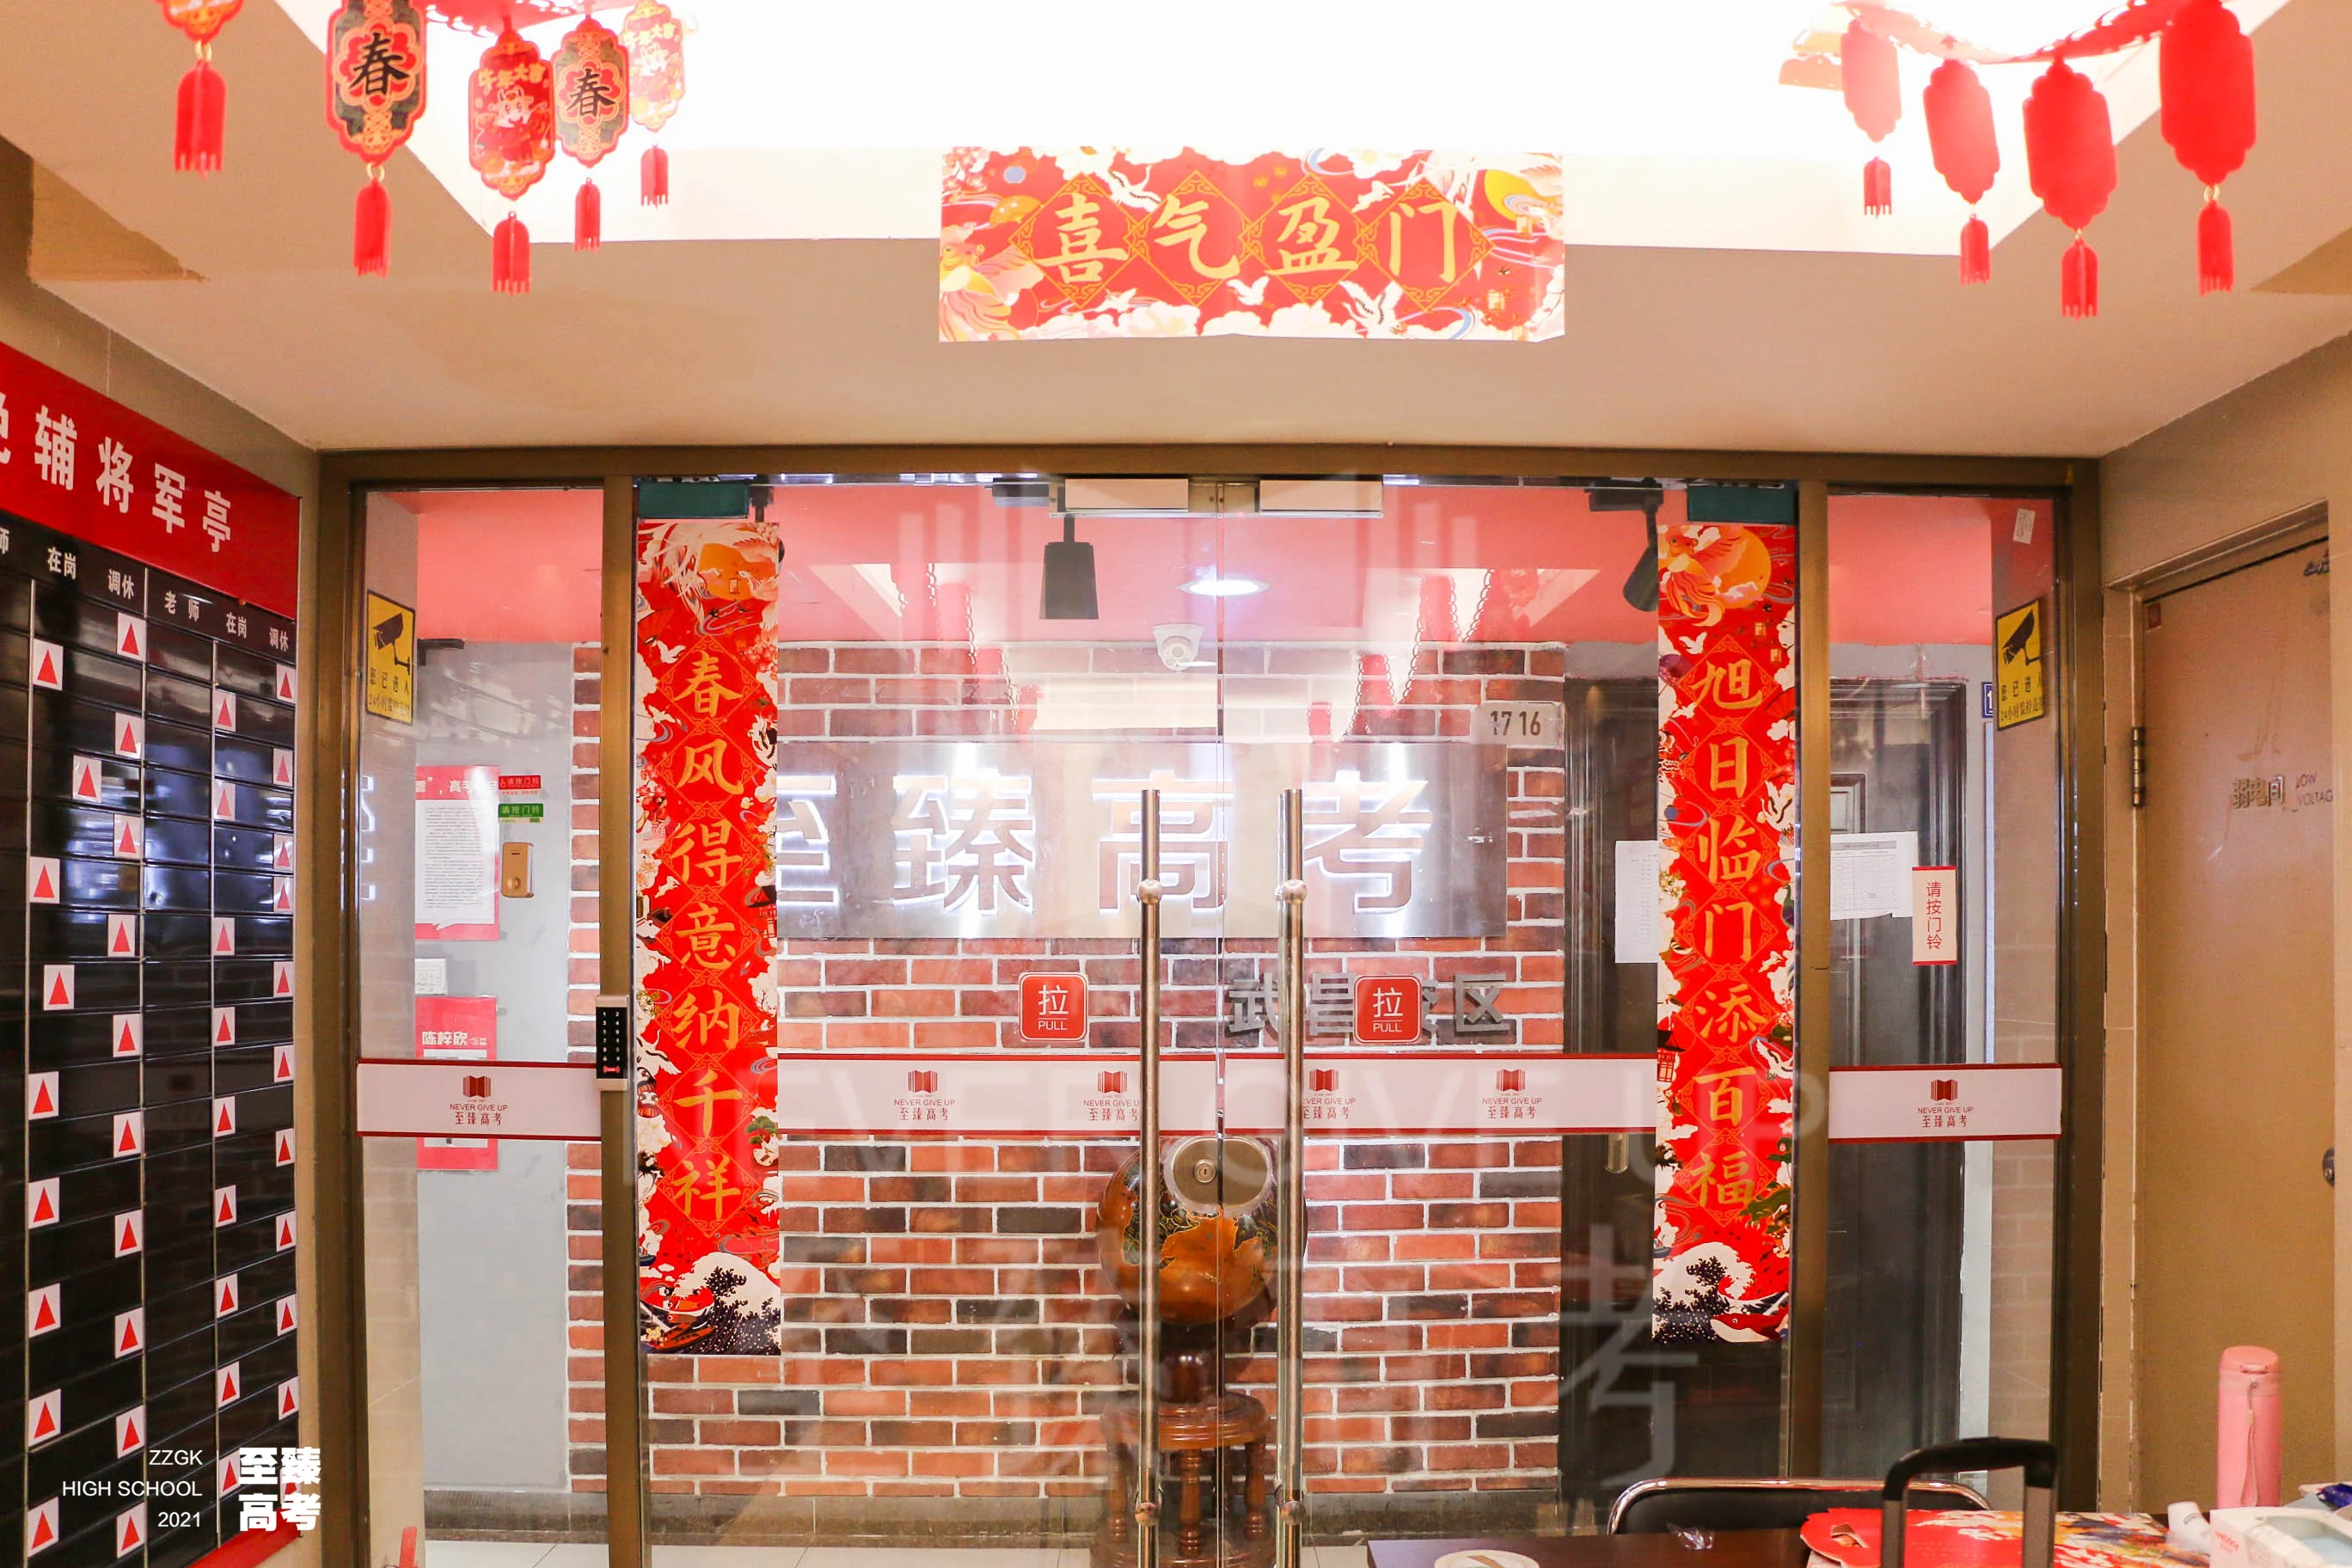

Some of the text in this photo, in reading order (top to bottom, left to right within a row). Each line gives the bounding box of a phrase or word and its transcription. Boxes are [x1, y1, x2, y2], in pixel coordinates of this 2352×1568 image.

[348, 32, 410, 96] 春
[565, 68, 617, 117] 春
[1033, 193, 1458, 285] 喜气盈门
[47, 546, 77, 580] 在岗
[108, 568, 135, 600] 调休
[226, 611, 248, 639] 在岗
[269, 626, 289, 652] 调休
[1490, 710, 1541, 736] 1716
[1926, 880, 1943, 952] 请按门铃
[671, 649, 745, 1222] 春风得意纳千祥
[1689, 658, 1768, 1208] 旭日临门添百福
[1038, 984, 1069, 1015] 拉
[1373, 987, 1404, 1018] 拉
[1038, 1020, 1069, 1031] PULL
[1373, 1022, 1403, 1032] PULL
